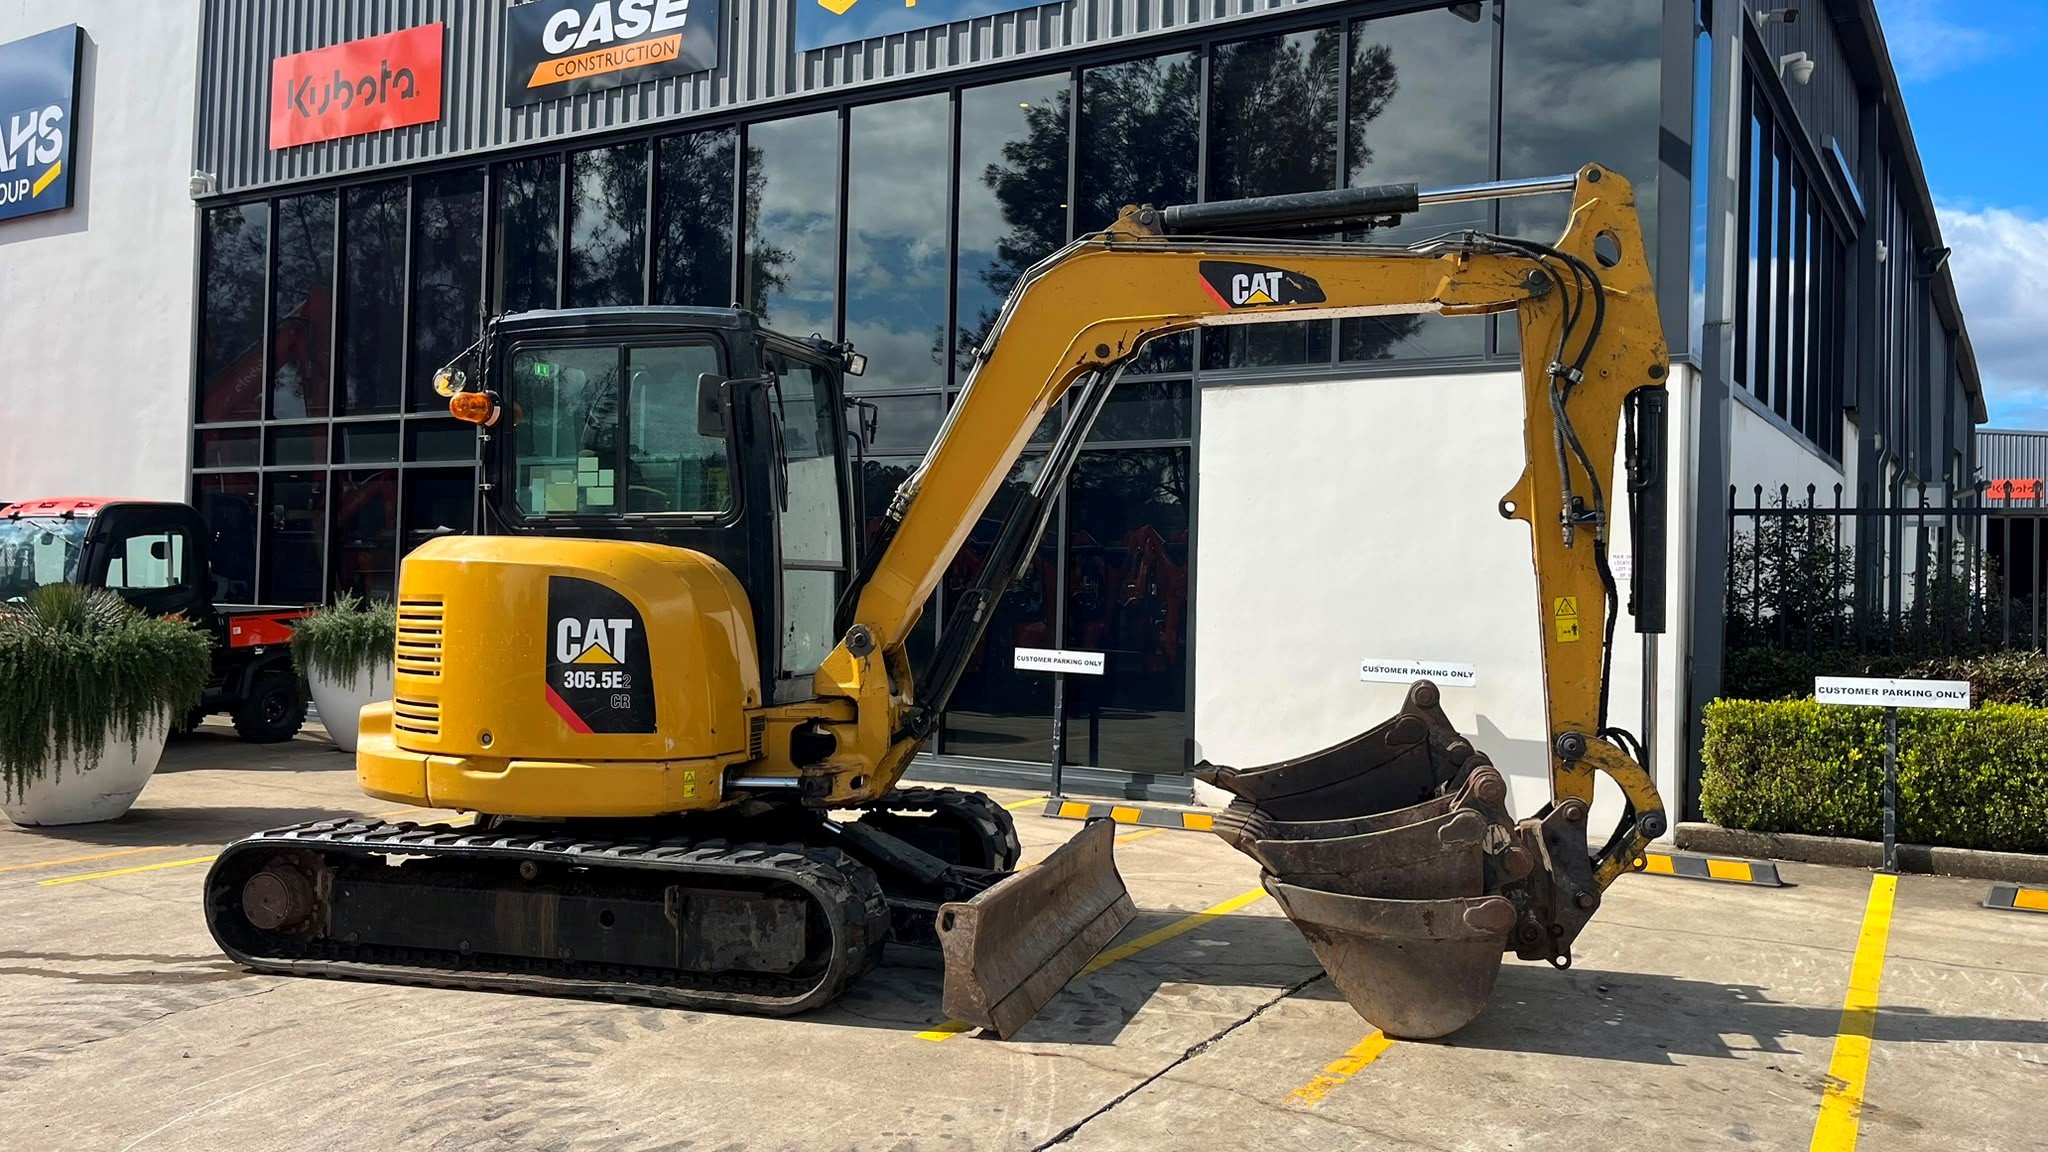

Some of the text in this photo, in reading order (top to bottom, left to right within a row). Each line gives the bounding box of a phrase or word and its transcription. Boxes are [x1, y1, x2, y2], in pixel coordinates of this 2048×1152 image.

[542, 0, 689, 55] CASE
[555, 40, 675, 77] CONSTRUCTION
[287, 60, 414, 118] Kubota
[1232, 271, 1283, 305] CAT
[557, 617, 632, 664] CAT
[1016, 655, 1052, 663] CUSTOMER
[1362, 665, 1474, 678] CUSTOMER PARKING ONLY
[611, 694, 630, 709] CR
[1818, 686, 1966, 699] CUSTOMER PARKING ONLY
